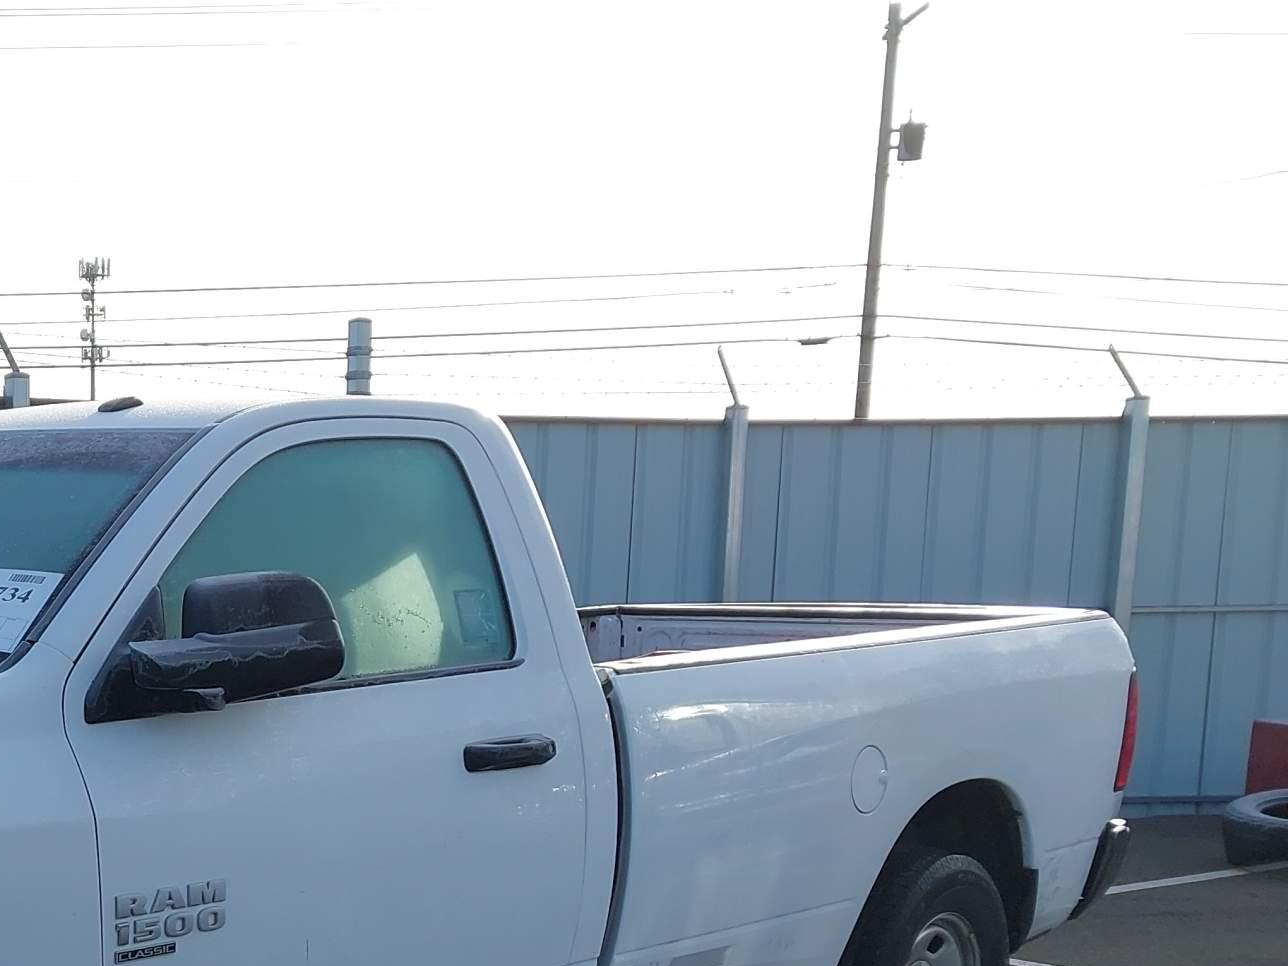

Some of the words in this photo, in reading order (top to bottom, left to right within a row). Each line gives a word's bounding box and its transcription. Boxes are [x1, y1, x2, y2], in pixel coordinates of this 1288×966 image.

[114, 879, 226, 920] RAM
[114, 906, 226, 947] 1500
[118, 943, 175, 962] CLASSIC
